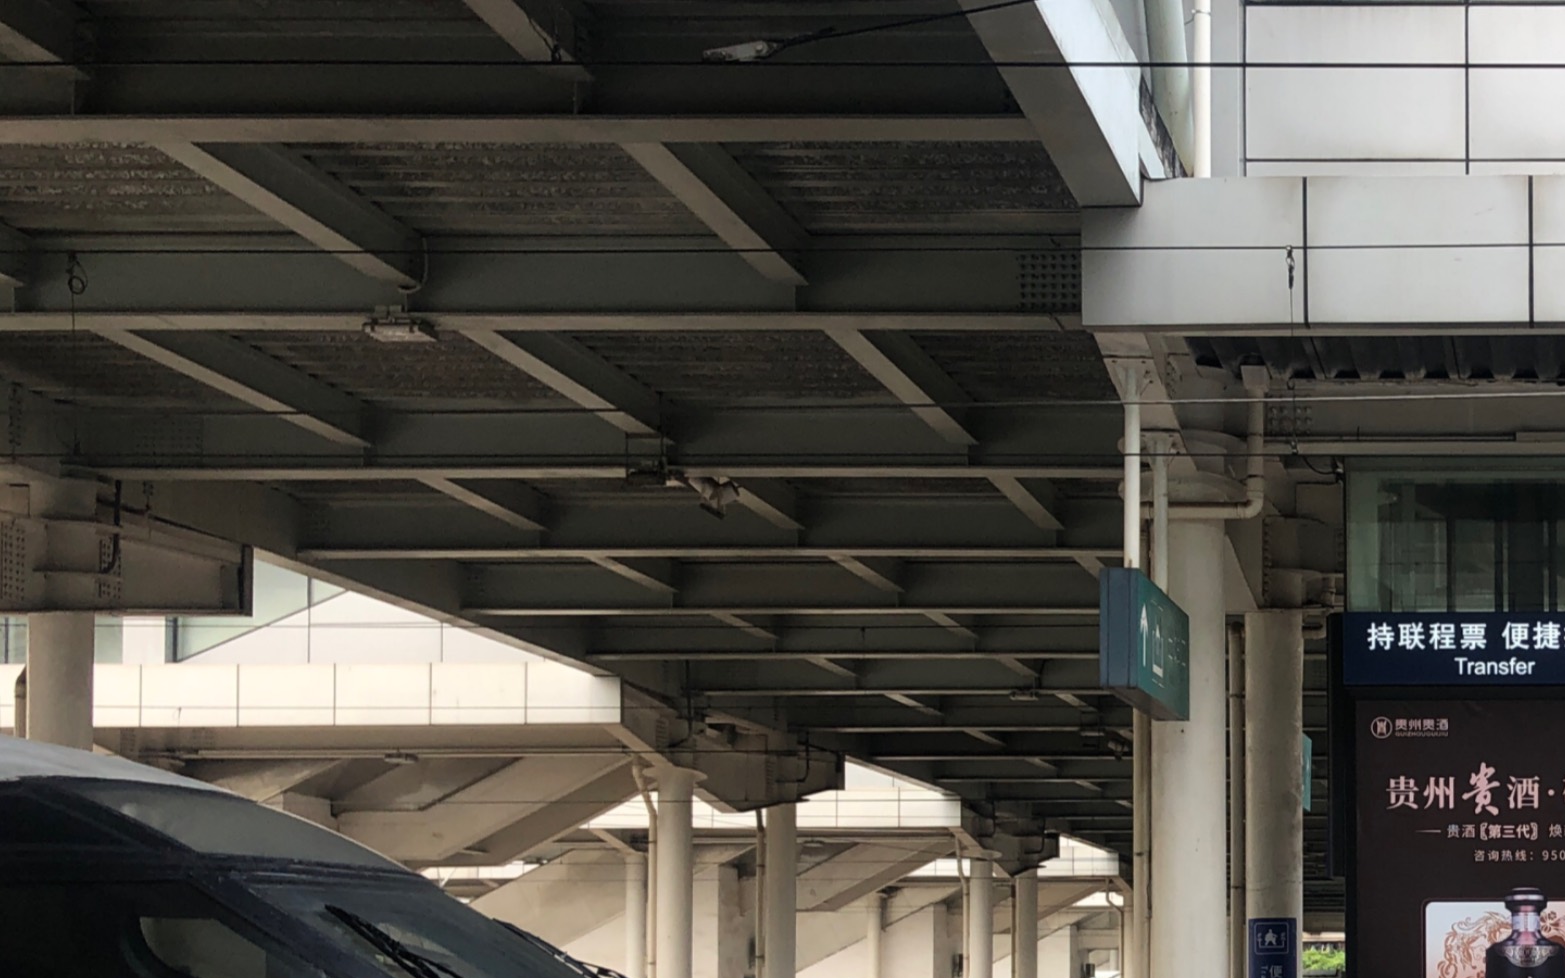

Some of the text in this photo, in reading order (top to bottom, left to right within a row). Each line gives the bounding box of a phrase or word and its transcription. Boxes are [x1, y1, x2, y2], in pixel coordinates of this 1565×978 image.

[1366, 621, 1487, 651] 持联程票
[1454, 657, 1536, 676] Transfer
